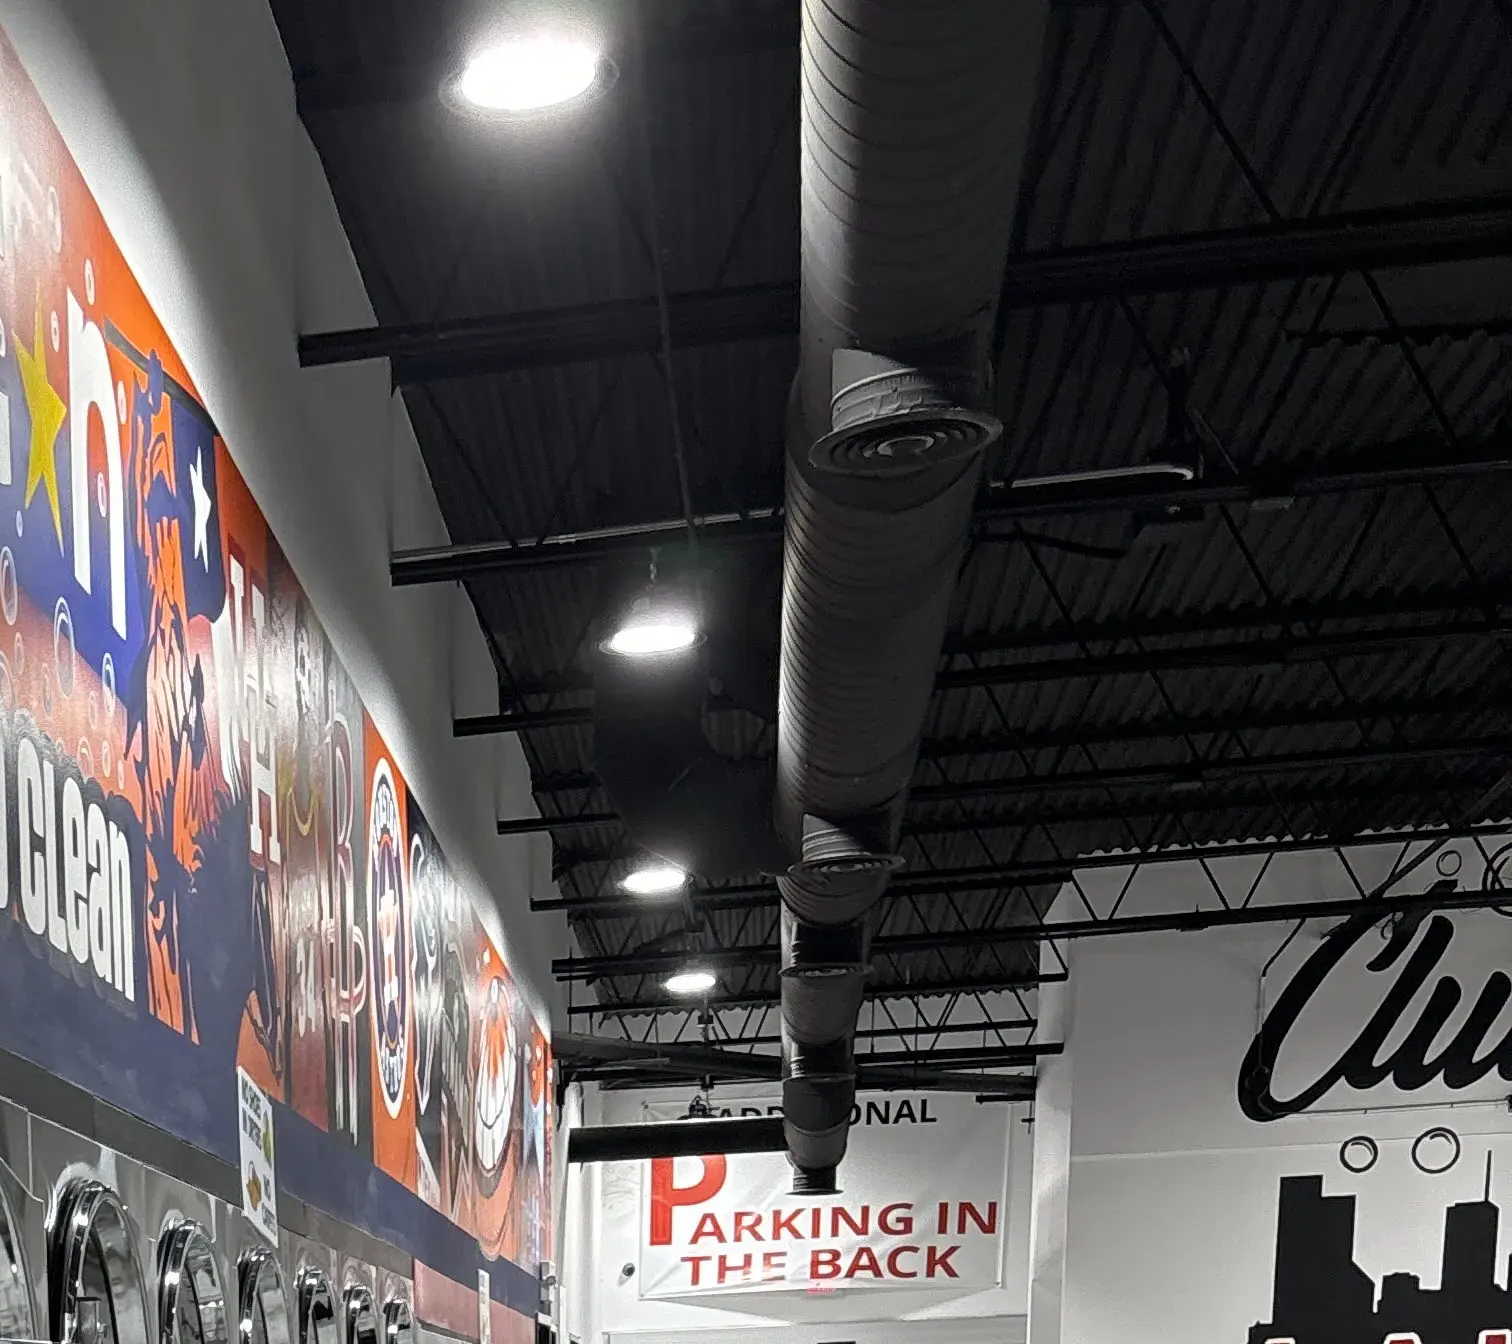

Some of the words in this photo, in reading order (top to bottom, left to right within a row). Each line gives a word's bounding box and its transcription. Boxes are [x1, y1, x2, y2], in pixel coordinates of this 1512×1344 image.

[649, 1153, 914, 1246] PARKING
[937, 1201, 998, 1235] IN
[681, 1251, 788, 1286] THE
[809, 1245, 961, 1280] BACK
